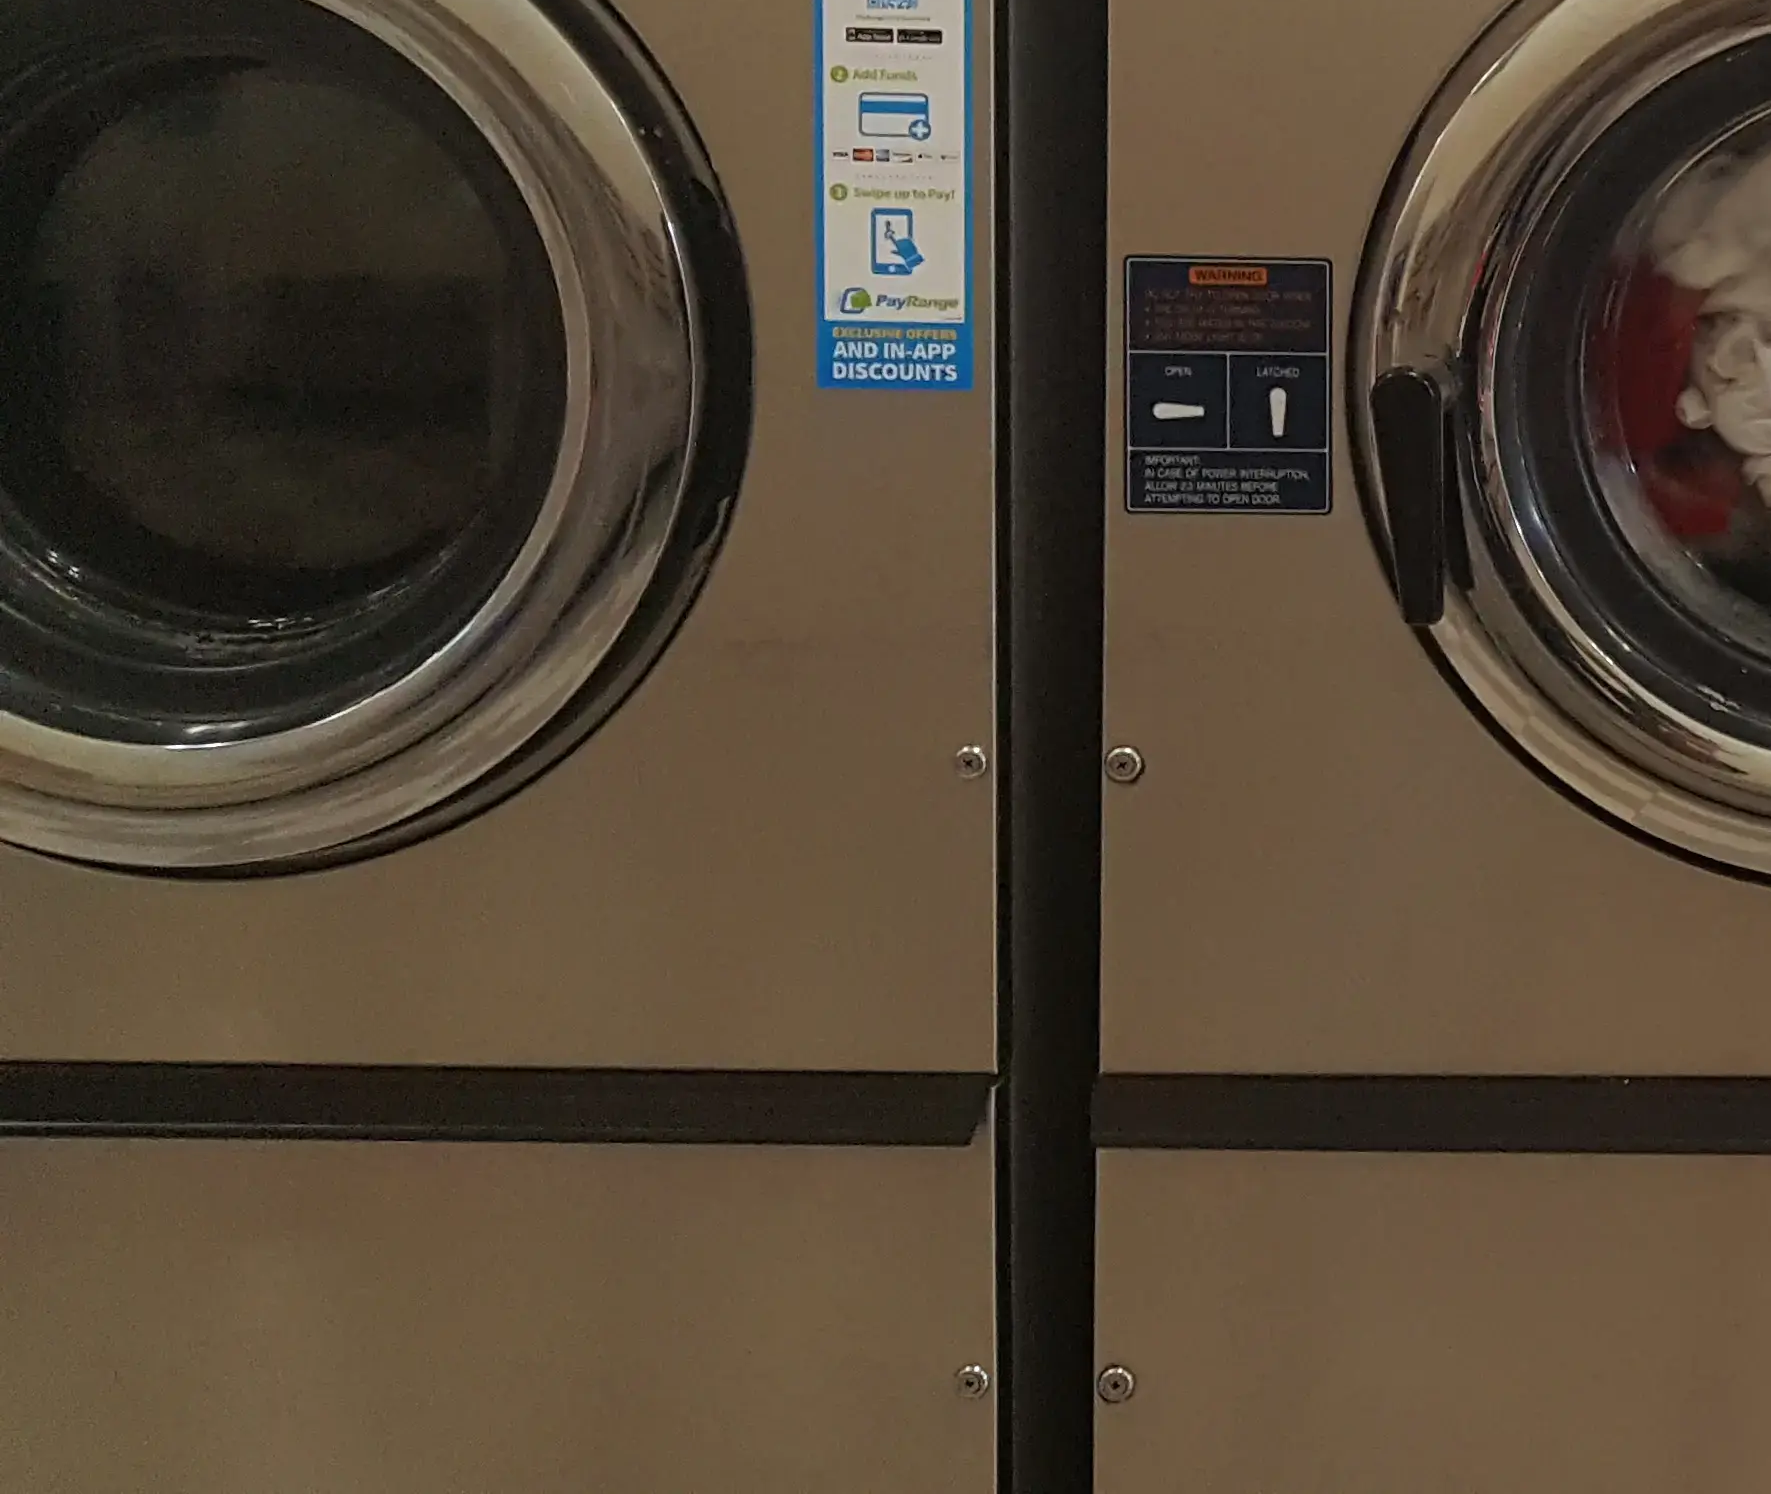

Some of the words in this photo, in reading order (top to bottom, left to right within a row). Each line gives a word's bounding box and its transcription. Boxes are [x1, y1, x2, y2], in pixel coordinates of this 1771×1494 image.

[853, 68, 878, 81] Add
[881, 69, 917, 81] Funds
[854, 187, 891, 201] Swipe
[894, 190, 910, 201] up
[913, 189, 926, 199] to
[928, 188, 954, 201] Pay!
[1194, 269, 1263, 282] WARNING
[876, 294, 959, 311] PayRange
[833, 341, 877, 359] AND
[884, 342, 956, 361] IN-APP
[833, 362, 958, 382] DISCOUNTS
[1165, 367, 1192, 377] OPEN
[1256, 367, 1300, 378] LATCHED
[1157, 468, 1182, 479] CASE
[1202, 469, 1237, 479] POWER
[1223, 493, 1249, 504] OPEN
